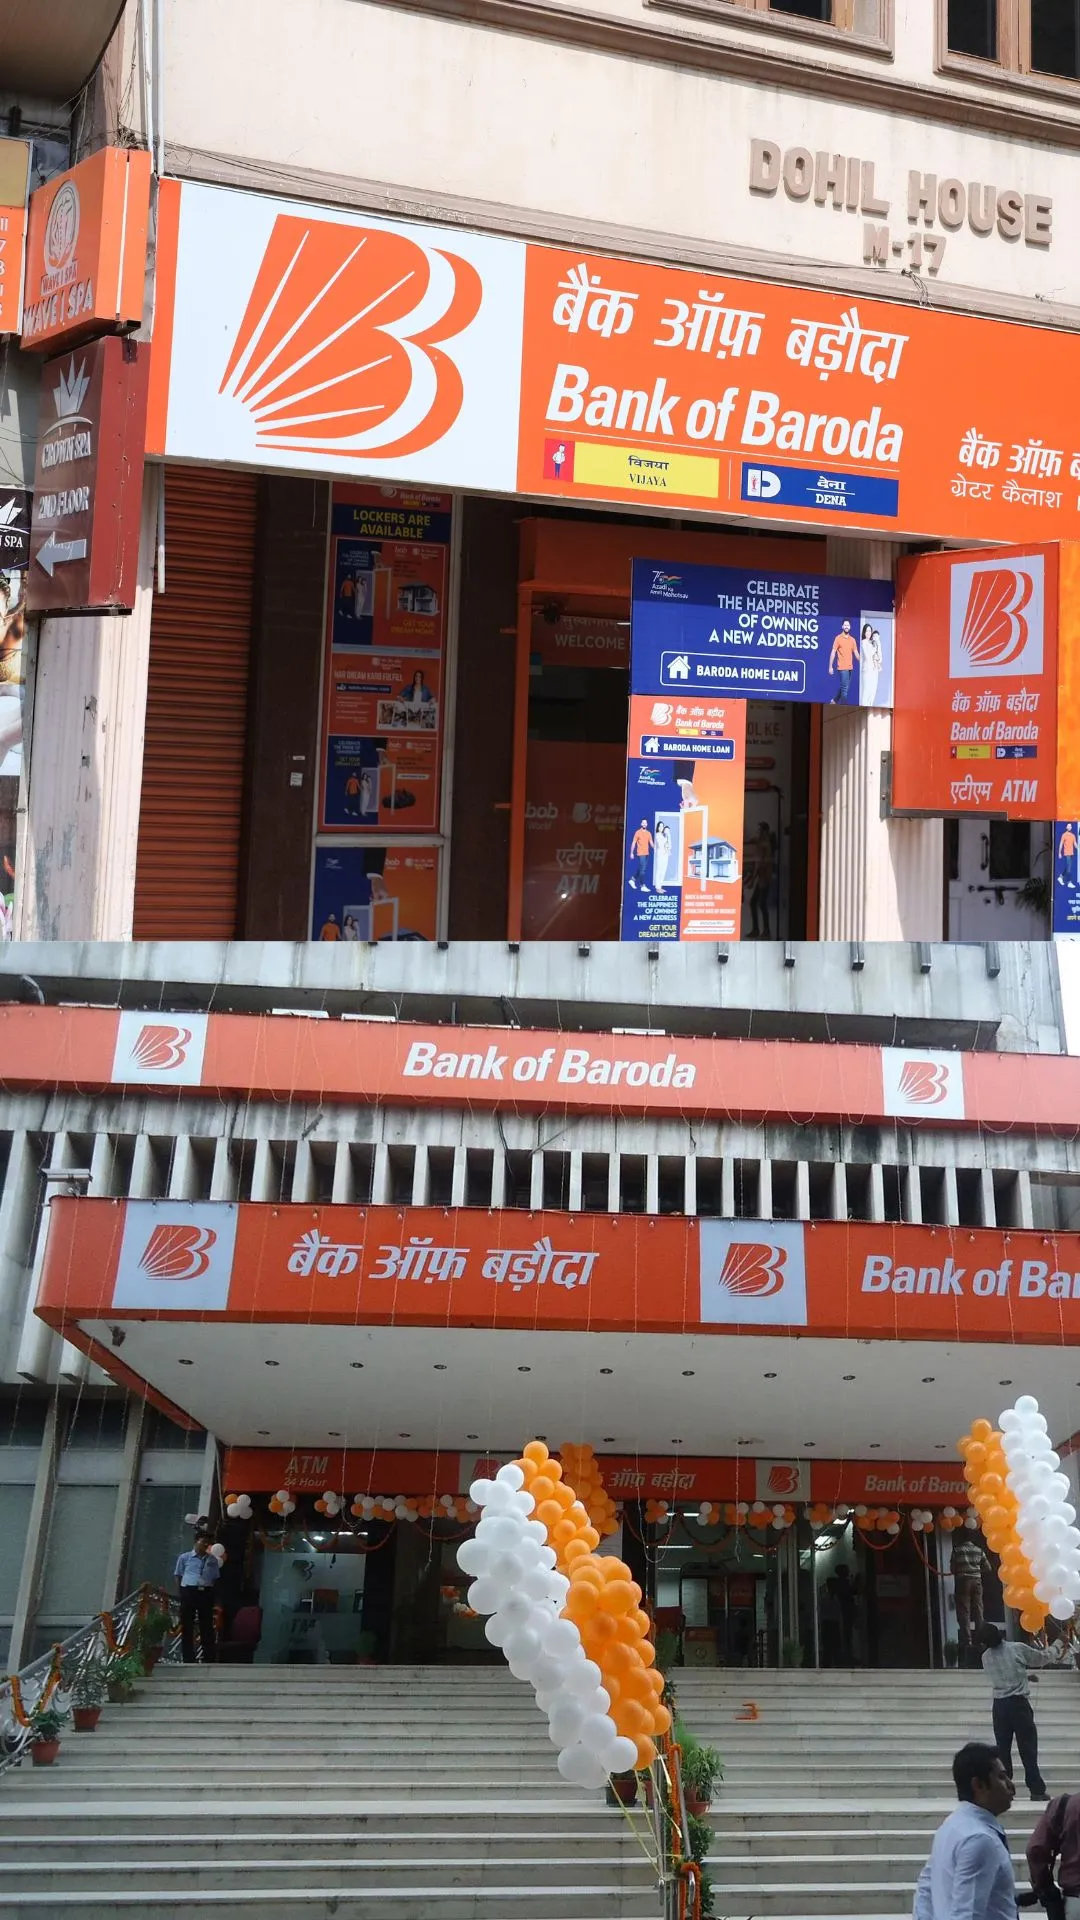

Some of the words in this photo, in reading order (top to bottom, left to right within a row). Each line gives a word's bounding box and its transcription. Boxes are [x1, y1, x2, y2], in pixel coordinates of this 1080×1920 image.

[749, 138, 889, 219] DOHIL
[907, 169, 1053, 250] HOUSE
[863, 222, 947, 276] M-17
[23, 293, 58, 338] WAVE
[67, 276, 94, 319] SPA
[552, 262, 640, 339] बैंक
[653, 289, 765, 361] ऑफ़
[785, 306, 909, 384] बड़ौदा
[545, 363, 682, 437] Bank
[685, 386, 739, 441] of
[740, 389, 905, 463] Baroda
[41, 435, 74, 469] CROWN
[74, 431, 92, 459] SPA
[958, 427, 1003, 469] बैंक
[1005, 438, 1064, 479] ऑफ़
[627, 455, 670, 473] विजया
[629, 473, 667, 488] VIJAYA
[951, 472, 995, 501] ग्रेटर
[1001, 479, 1063, 509] कैलाश
[38, 494, 56, 520] 2ND
[57, 485, 90, 516] FLOOR
[815, 493, 847, 507] DENA
[353, 509, 405, 524] LOCKERS
[408, 515, 431, 526] ARE
[4, 535, 23, 548] SPA
[360, 524, 423, 539] AVAILABLE
[747, 580, 819, 600] CELEBRATE
[717, 594, 743, 611] THE
[746, 598, 819, 616] HAPPINESS
[738, 614, 758, 629] OF
[761, 615, 819, 633] OWNING
[555, 634, 626, 650] WELCOME
[709, 628, 719, 643] A
[723, 629, 754, 646] NEW
[757, 632, 819, 650] ADDRESS
[696, 664, 739, 679] BARODA
[741, 667, 770, 680] HOME
[771, 669, 798, 682] LOAN
[952, 689, 971, 713] बैंक
[675, 718, 692, 728] Bank
[693, 720, 700, 728] of
[701, 720, 725, 730] Baroda
[950, 720, 981, 741] Bank
[982, 722, 995, 741] of
[995, 720, 1039, 742] Baroda
[663, 743, 691, 752] BARODA
[692, 745, 711, 753] HOME
[712, 745, 730, 754] LOAN
[950, 774, 993, 804] एटीएम
[1000, 780, 1038, 803] ATM
[525, 802, 558, 819] bob
[556, 842, 608, 869] एटीएम
[555, 874, 600, 894] ATM
[403, 1041, 509, 1082] Bank
[512, 1048, 555, 1084] of
[558, 1048, 697, 1089] Baroda
[287, 1228, 363, 1279] बैंक
[369, 1237, 470, 1285] ऑफ़
[481, 1236, 600, 1293] बड़ौदा
[861, 1255, 964, 1297] Bank
[969, 1260, 1013, 1298] of
[285, 1455, 329, 1474] ATM
[284, 1476, 297, 1487] 24
[298, 1477, 327, 1488] Hour
[864, 1474, 906, 1493] Bank
[908, 1477, 926, 1493] of
